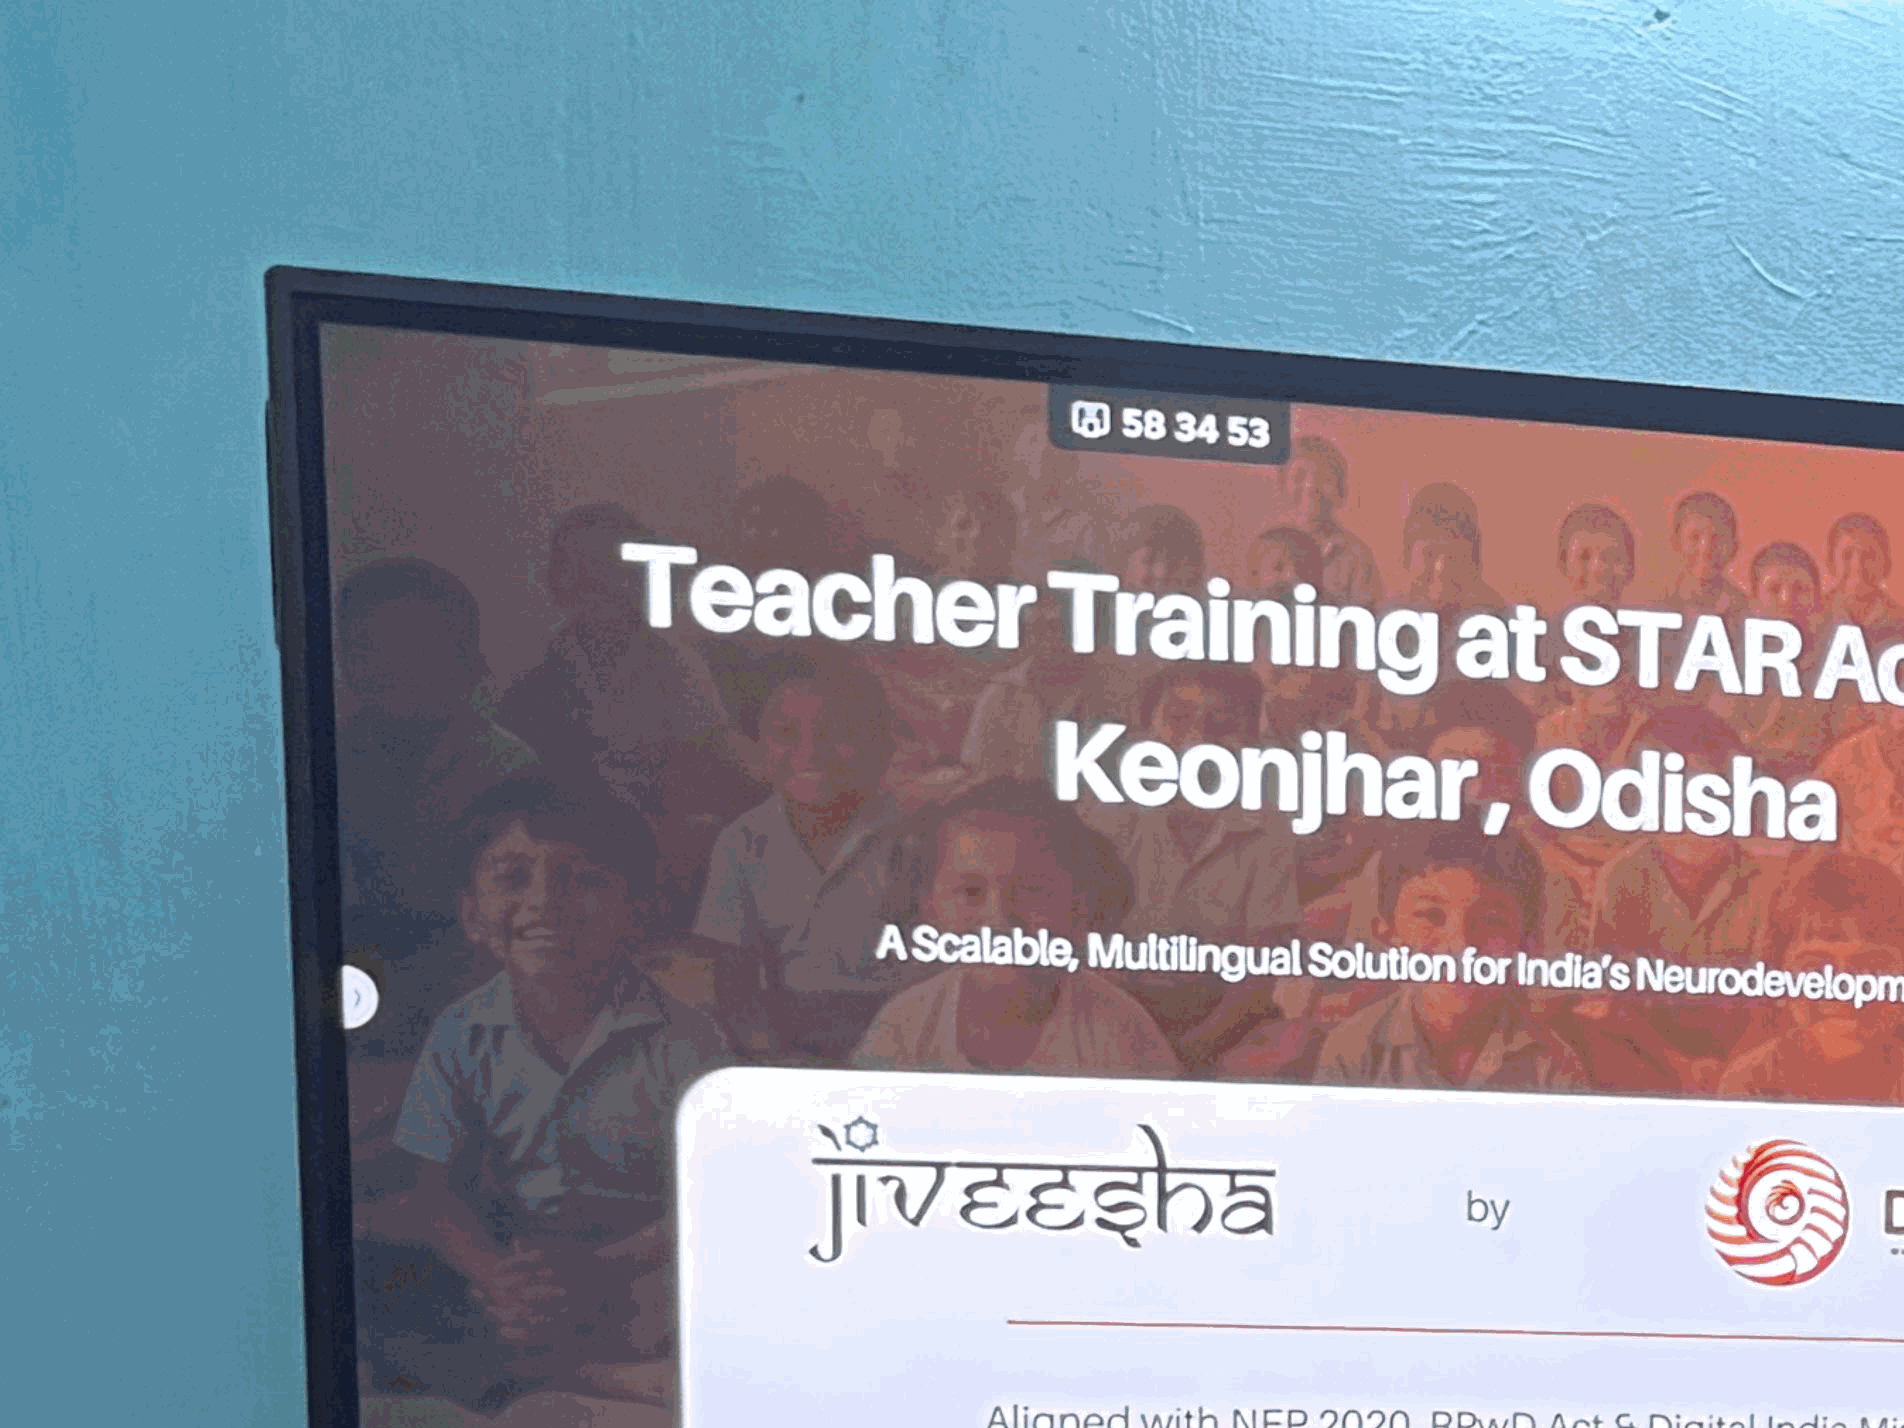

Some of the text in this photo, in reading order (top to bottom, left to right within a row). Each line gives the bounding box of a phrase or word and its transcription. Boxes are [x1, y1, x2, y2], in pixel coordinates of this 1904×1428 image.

[1122, 407, 1271, 448] 58 34 53
[620, 542, 1036, 651] Teacher
[1047, 570, 1441, 694] Training
[1456, 608, 1550, 683] at
[1560, 605, 1803, 699] STAR
[1529, 748, 1838, 842] Odisha
[875, 924, 908, 961] A
[911, 924, 1080, 972] Scalable,
[1088, 933, 1301, 983] Multilingual
[1307, 942, 1456, 983] Solution
[1461, 946, 1509, 985] for
[1465, 1190, 1511, 1230] by
